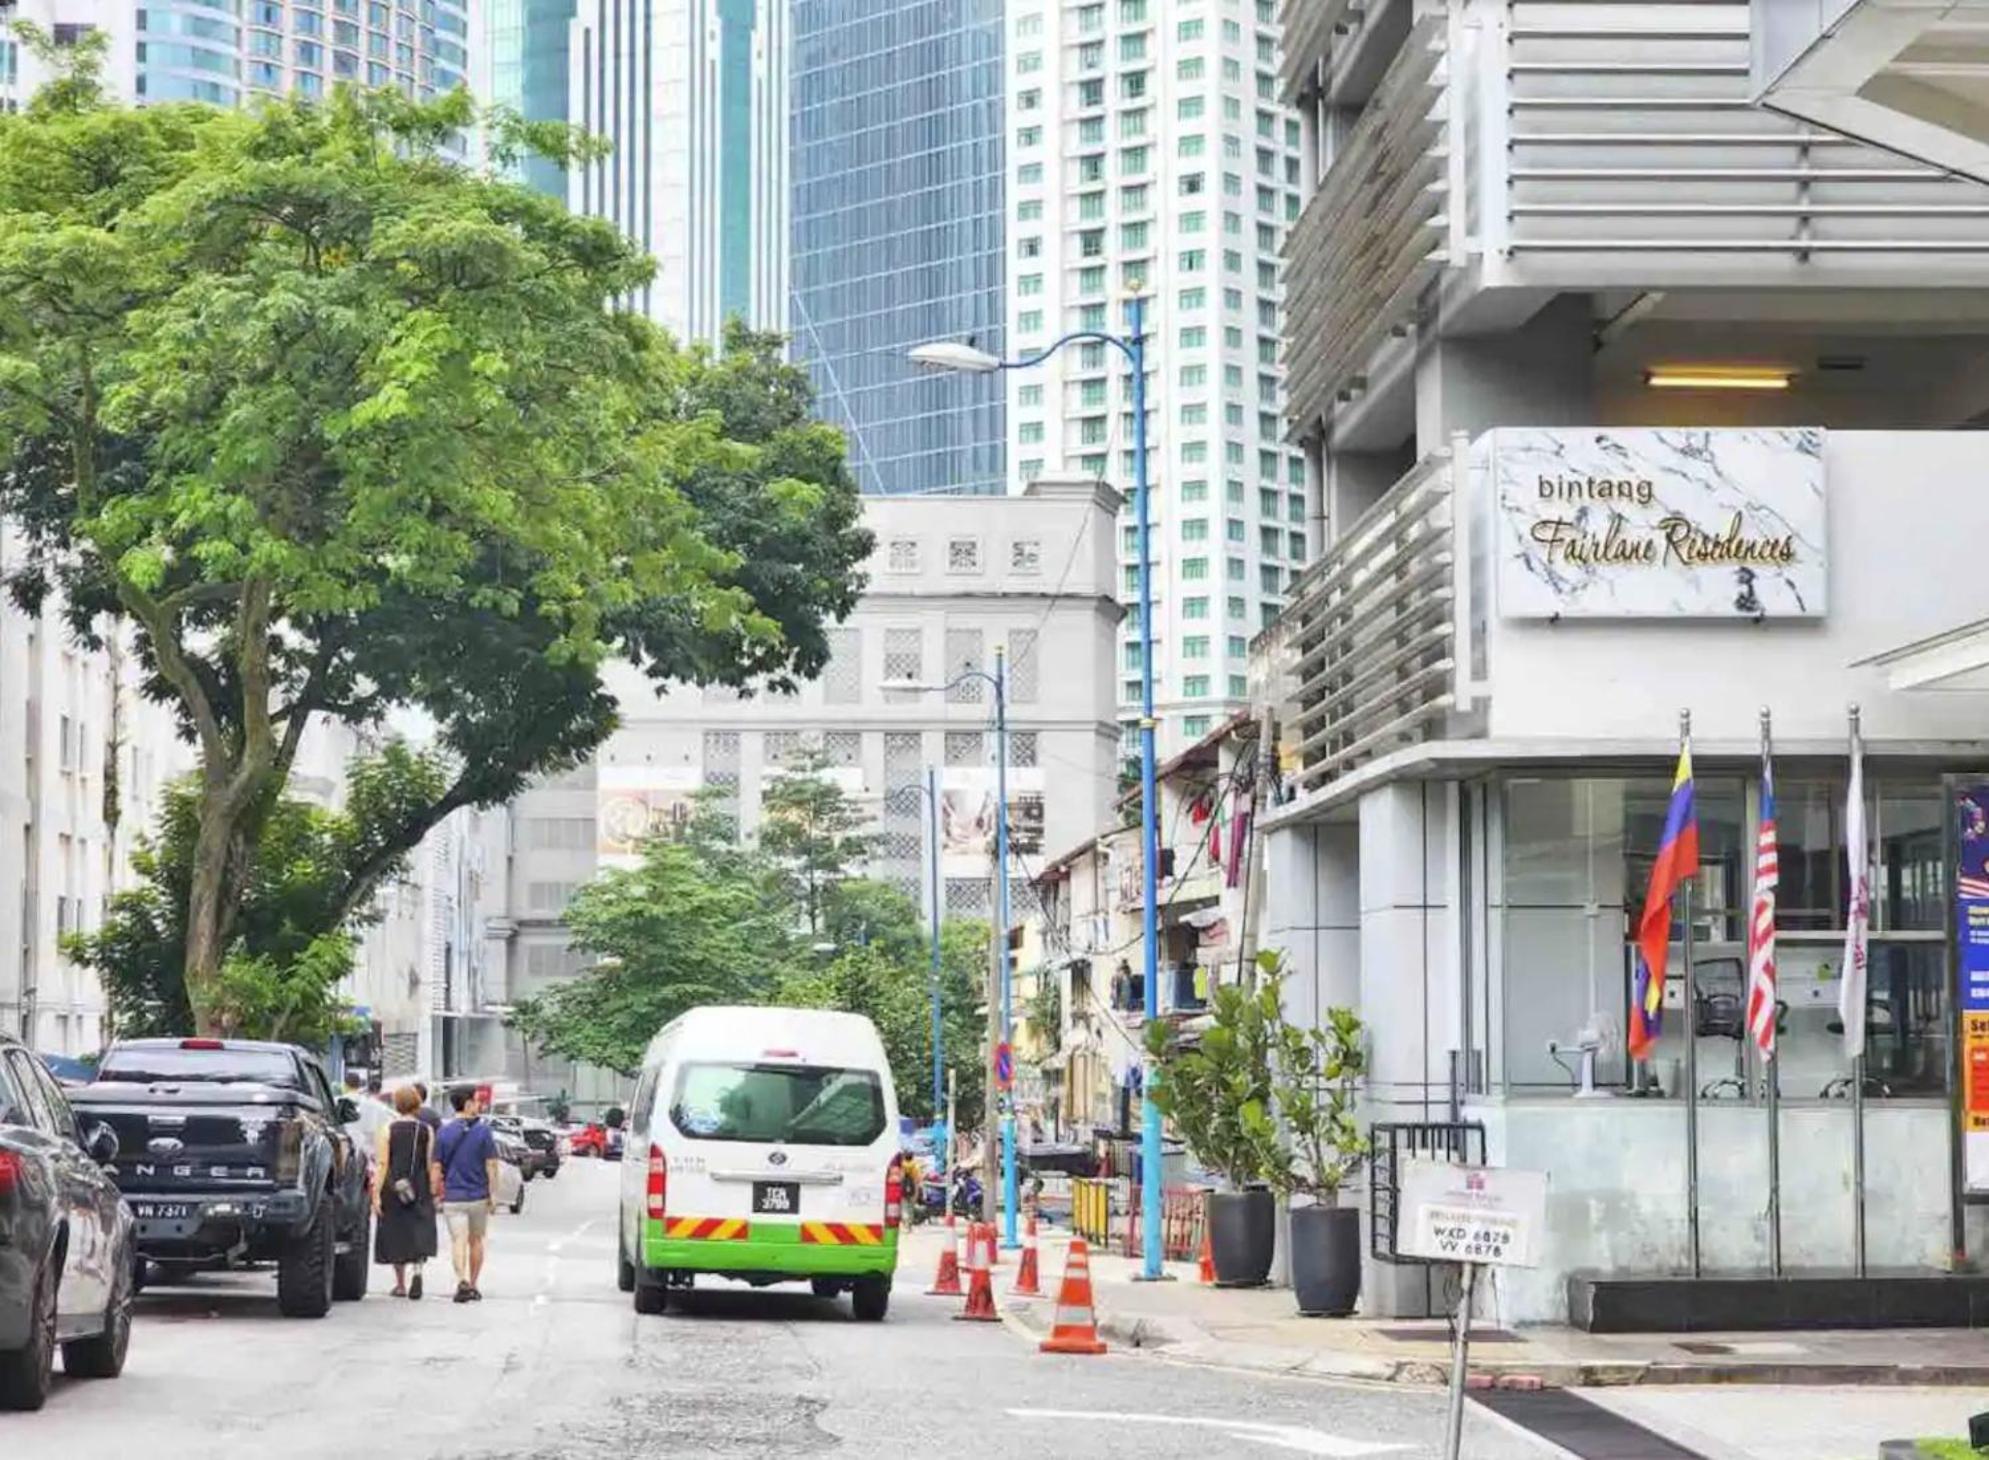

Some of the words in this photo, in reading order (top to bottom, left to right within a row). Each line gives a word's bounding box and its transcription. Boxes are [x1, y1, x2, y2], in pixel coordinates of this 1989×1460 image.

[1537, 475, 1654, 504] bintang
[1530, 515, 1657, 565] Fairlane
[1657, 510, 1796, 567] Residences
[102, 1164, 265, 1177] ANGER
